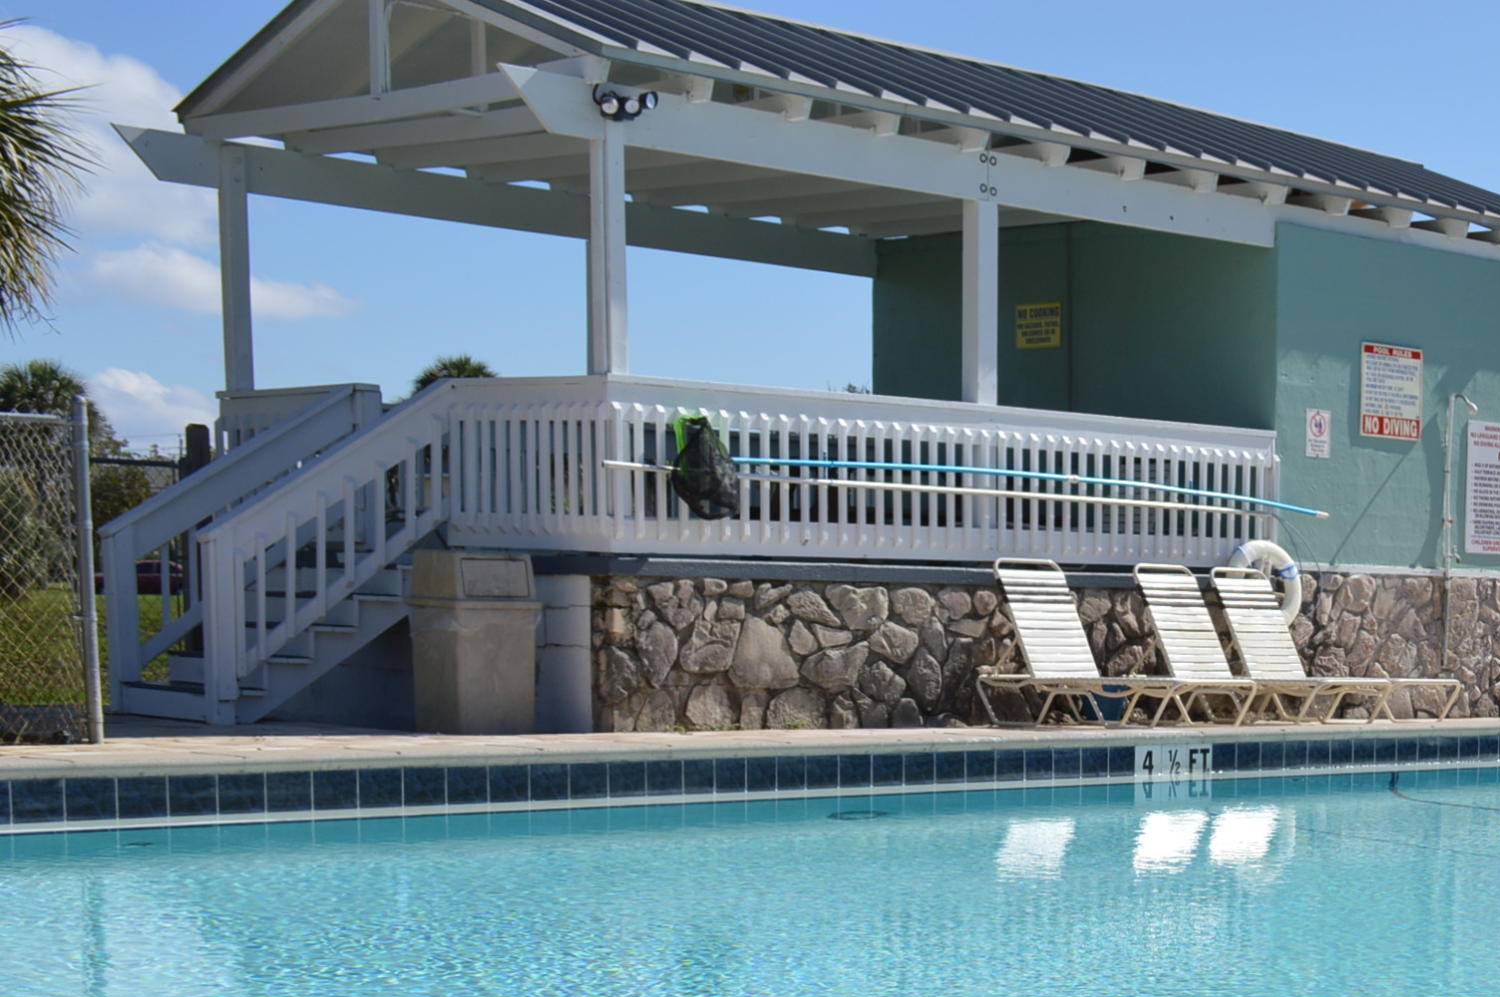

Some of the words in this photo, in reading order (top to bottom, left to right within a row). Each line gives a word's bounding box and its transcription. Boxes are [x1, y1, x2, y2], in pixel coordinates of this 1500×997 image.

[1373, 345, 1390, 356] POOL
[1391, 348, 1412, 359] RULES
[1364, 415, 1380, 434] NO
[1383, 417, 1418, 438] DIVING
[1142, 750, 1154, 775] 4
